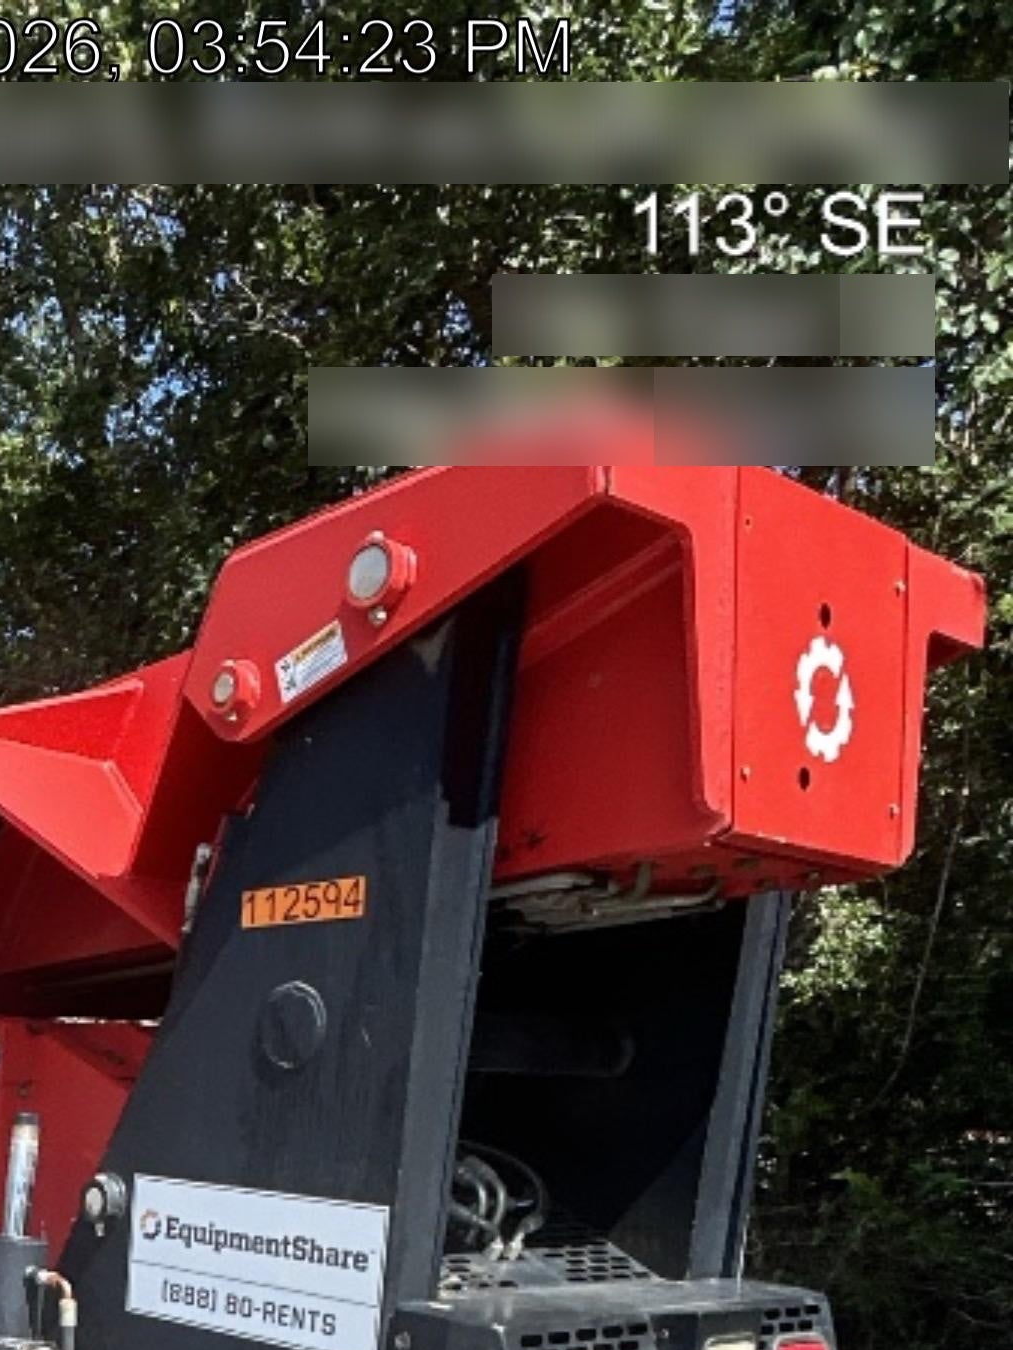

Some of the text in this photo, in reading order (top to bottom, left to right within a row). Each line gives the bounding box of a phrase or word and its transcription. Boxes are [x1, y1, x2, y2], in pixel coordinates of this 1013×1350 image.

[244, 877, 363, 925] 112594
[165, 1214, 370, 1273] EquipmentShare
[224, 1292, 337, 1336] 80-RENTS
